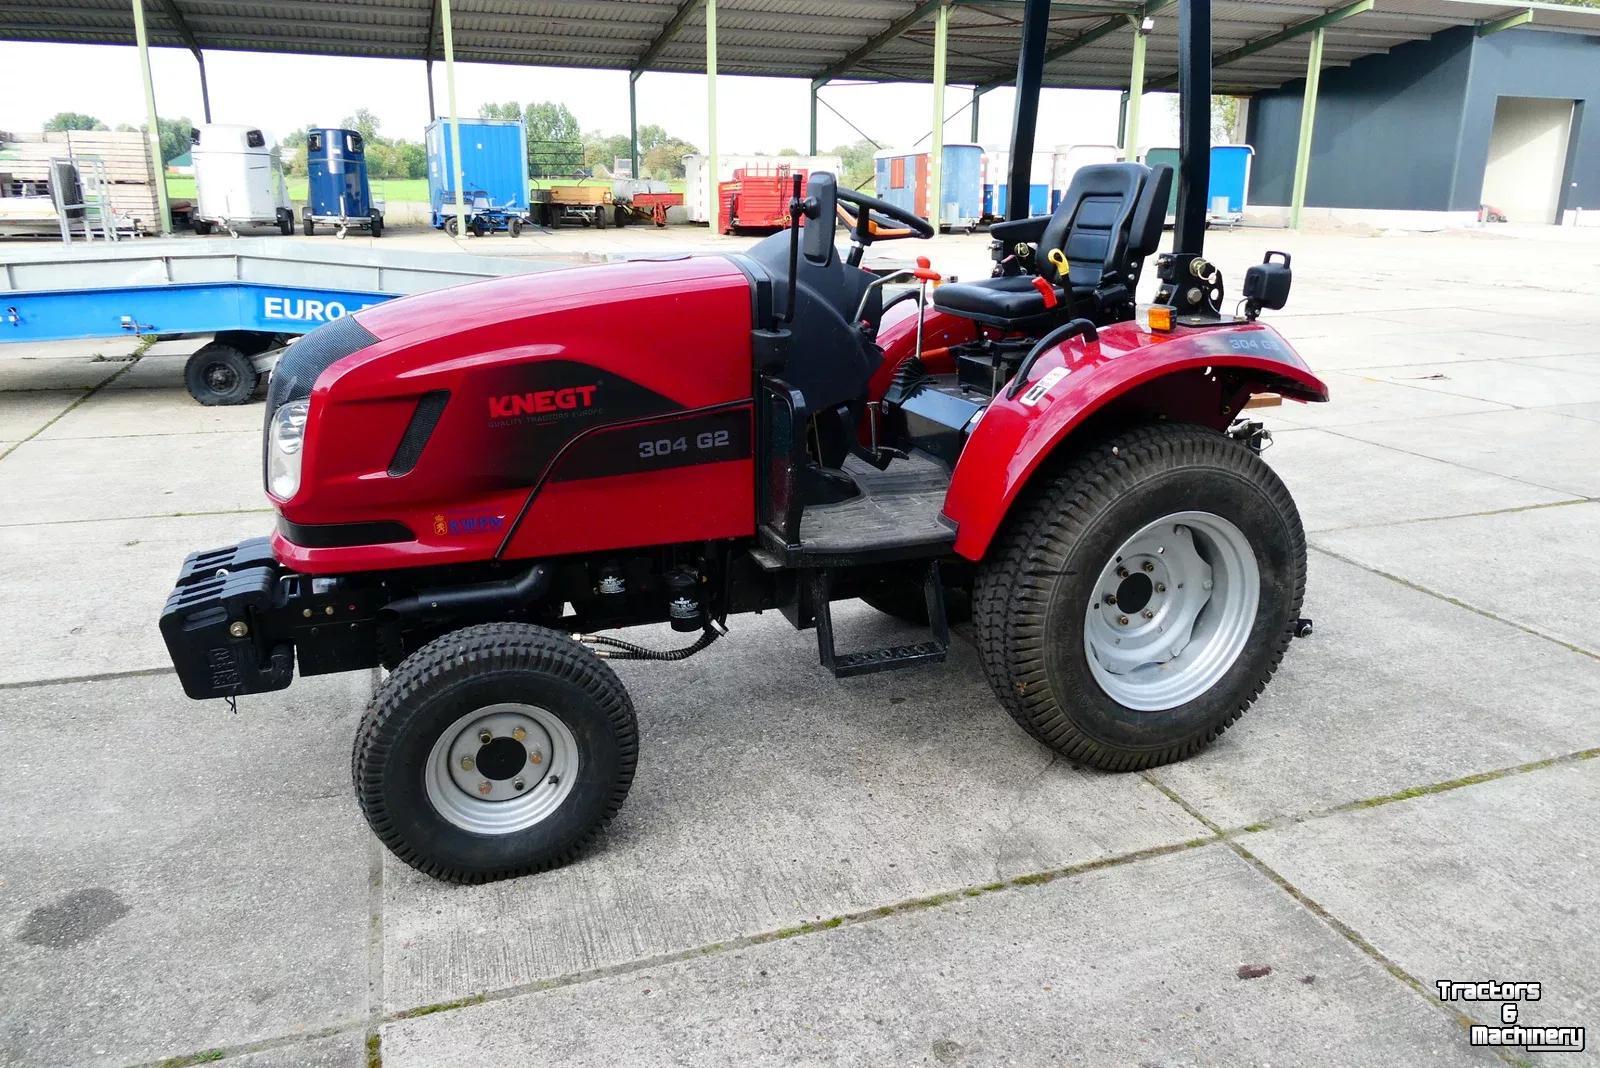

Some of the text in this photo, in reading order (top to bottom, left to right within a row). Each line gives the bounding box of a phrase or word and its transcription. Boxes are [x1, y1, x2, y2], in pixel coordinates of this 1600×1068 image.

[1230, 339, 1258, 349] 304
[488, 385, 597, 418] KNEGT
[638, 430, 730, 458] 304 G2
